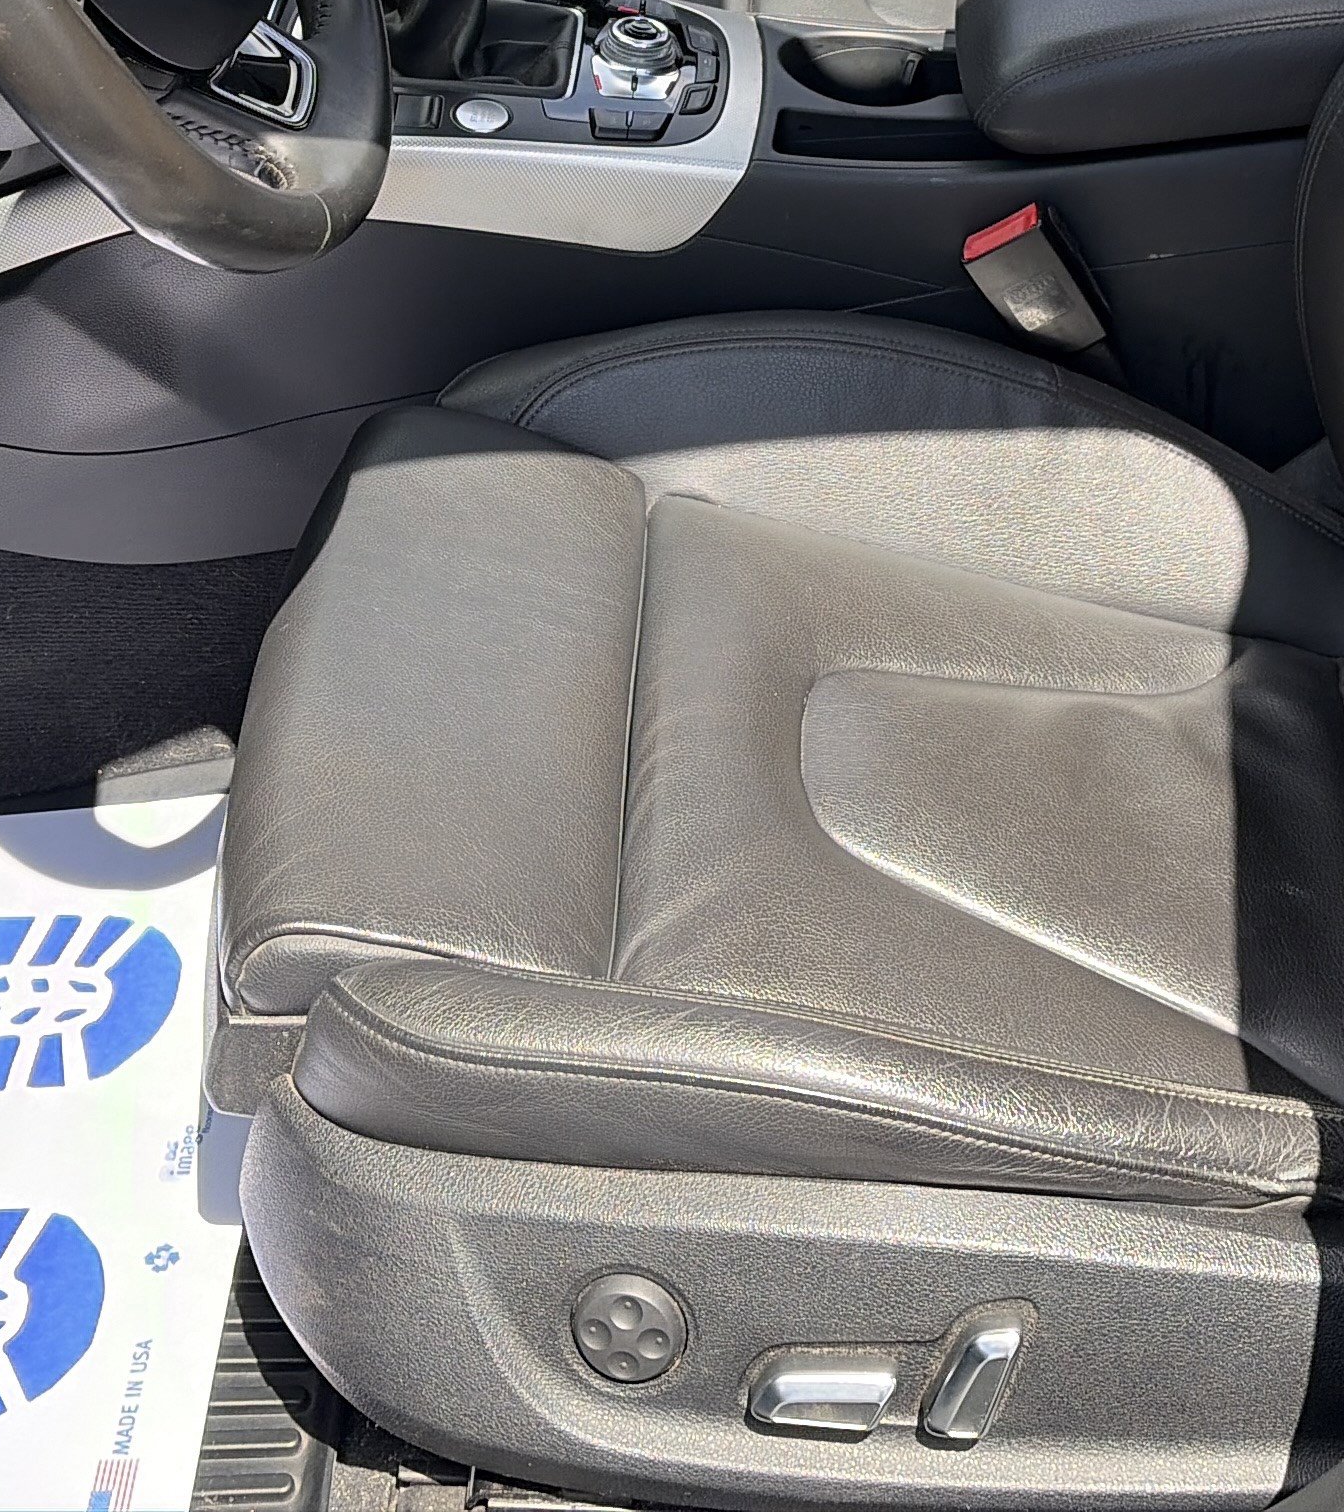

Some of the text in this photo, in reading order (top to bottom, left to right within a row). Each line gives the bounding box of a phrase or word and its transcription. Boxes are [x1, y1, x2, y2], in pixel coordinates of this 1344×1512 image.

[112, 1338, 154, 1455] MADE IN USA
